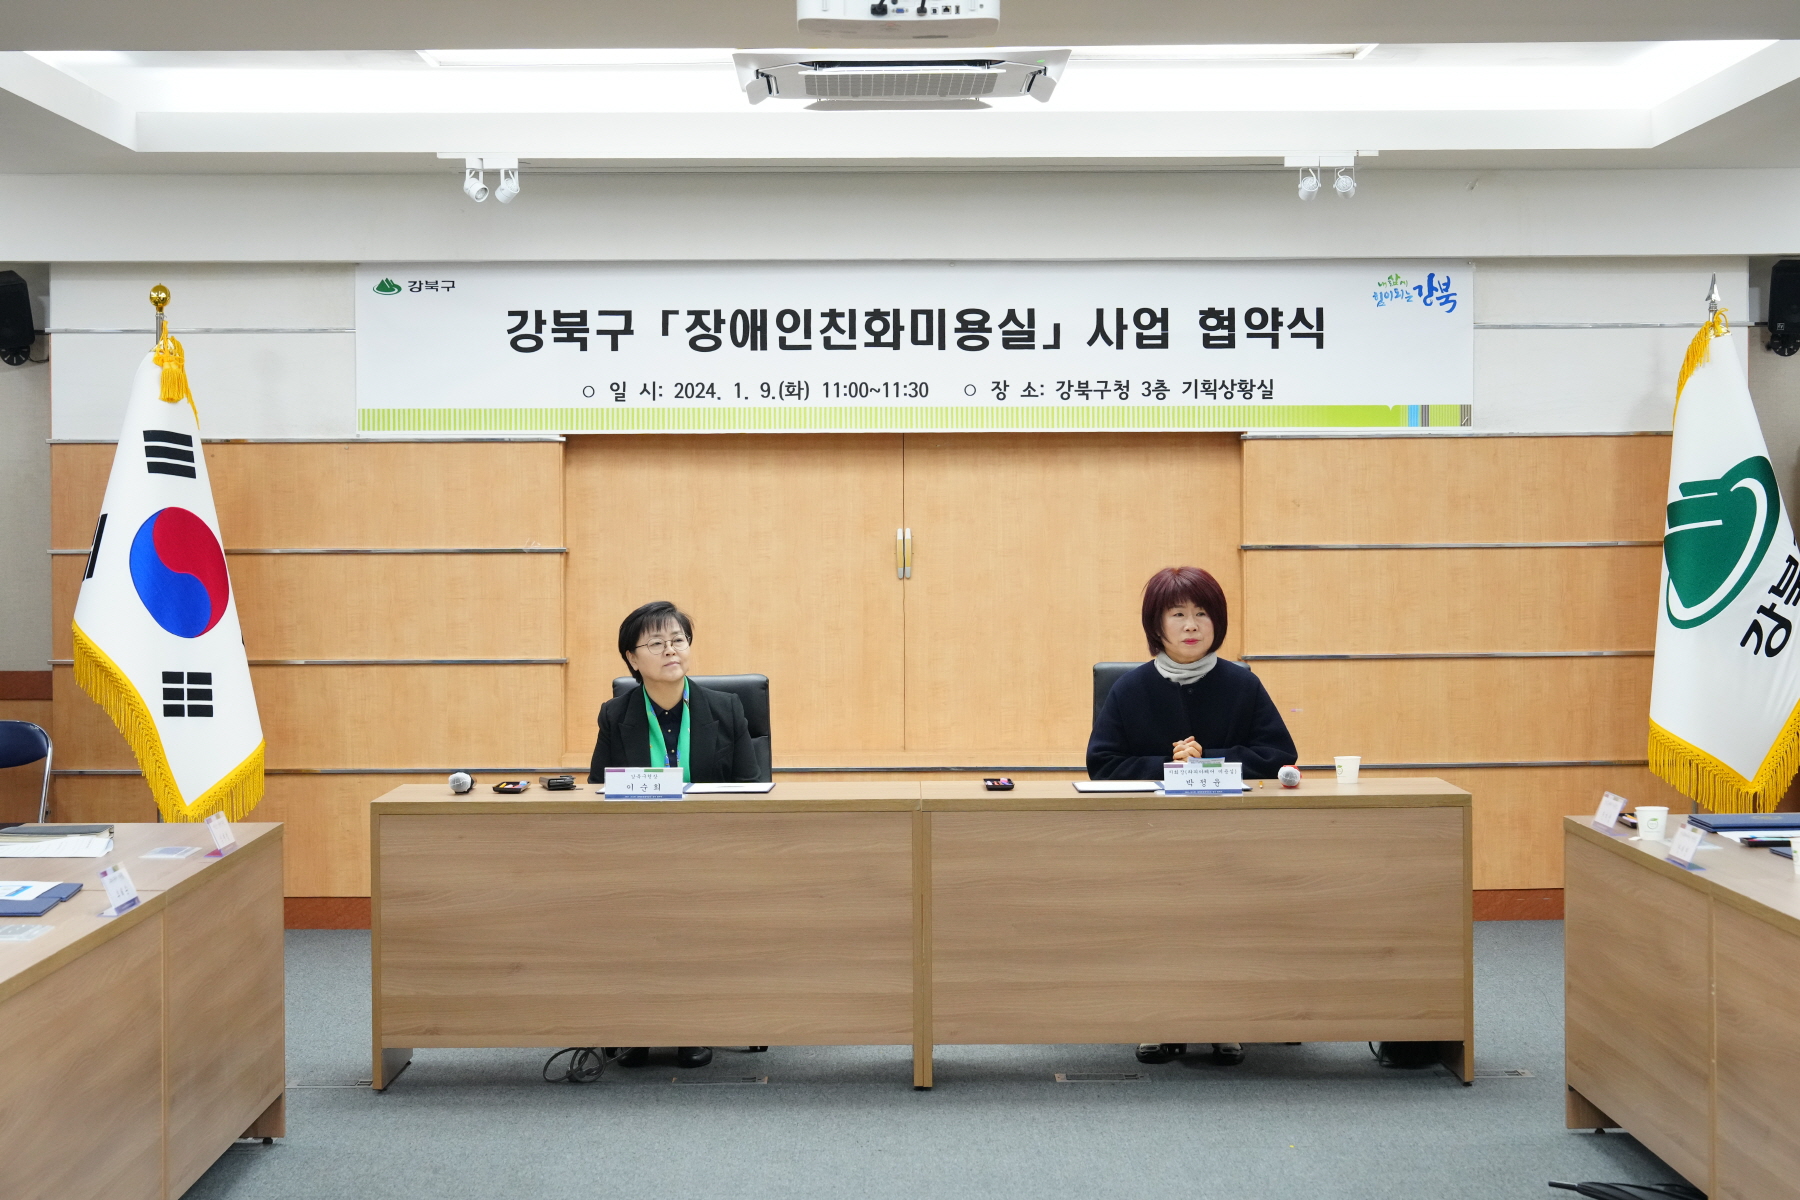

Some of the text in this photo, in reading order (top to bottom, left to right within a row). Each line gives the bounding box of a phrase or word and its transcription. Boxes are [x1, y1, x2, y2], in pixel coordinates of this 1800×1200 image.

[407, 279, 456, 293] 강북구
[1412, 272, 1457, 313] 강북
[506, 306, 1325, 353] 강북구 「장애인친화미용실」 사업 협약식
[674, 382, 721, 400] 2024.
[734, 382, 748, 400] 1.
[760, 380, 810, 401] 9.(화)
[822, 381, 929, 399] 11:00~11:30
[1055, 379, 1130, 400] 강북구청
[1141, 379, 1171, 400] 3층
[1182, 379, 1274, 400] 기획상황실
[1740, 536, 1800, 657] 강북
